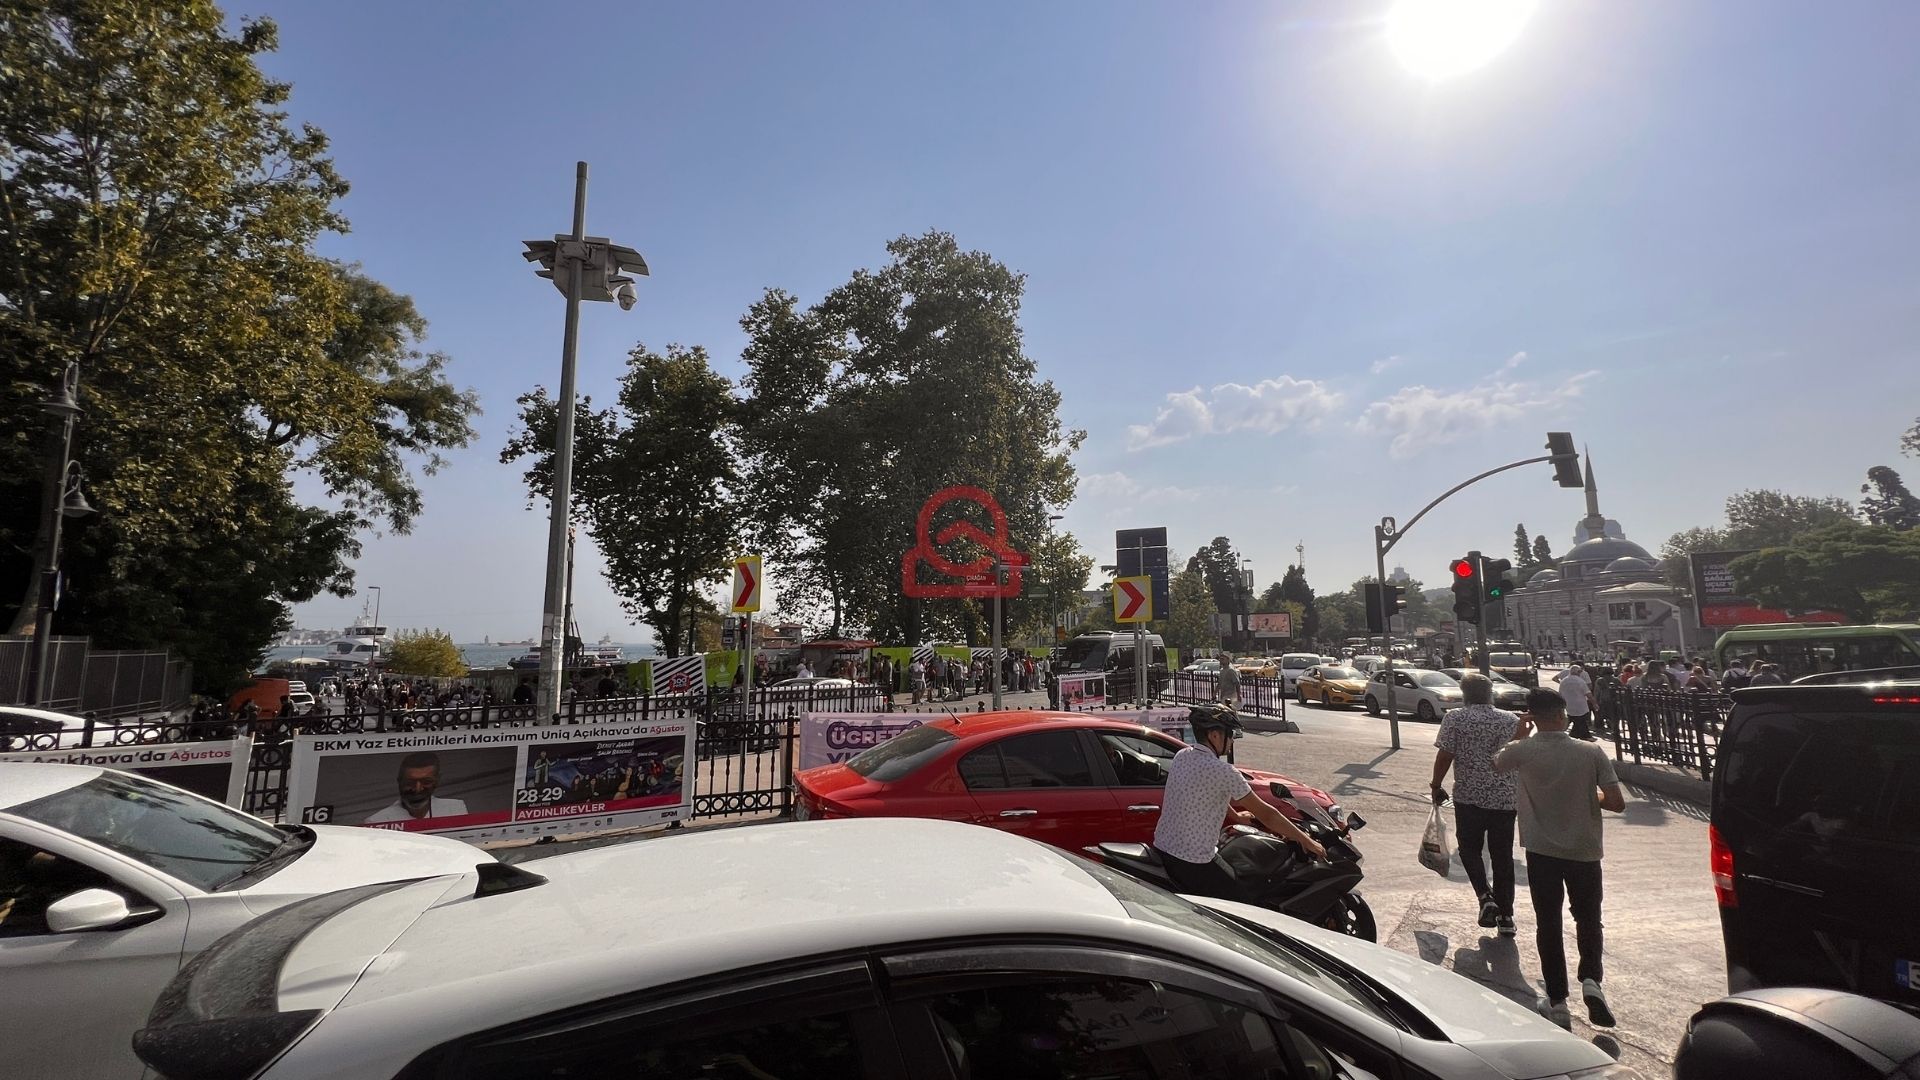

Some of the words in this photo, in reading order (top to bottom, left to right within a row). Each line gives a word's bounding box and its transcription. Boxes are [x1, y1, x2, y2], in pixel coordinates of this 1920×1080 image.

[313, 740, 350, 752] BKM
[356, 739, 383, 750] Yaz
[387, 734, 467, 748] Etkinlikleri
[470, 731, 538, 744] Maximum
[541, 729, 570, 740] Uniq
[573, 725, 648, 738] Açıkhava'da
[650, 724, 685, 735] Ağustos
[832, 727, 900, 744] ÜCRET
[170, 750, 232, 761] Ağustos
[517, 787, 563, 804] 28-29
[305, 807, 329, 822] 16
[517, 803, 606, 820] AYDINLIKEVLER
